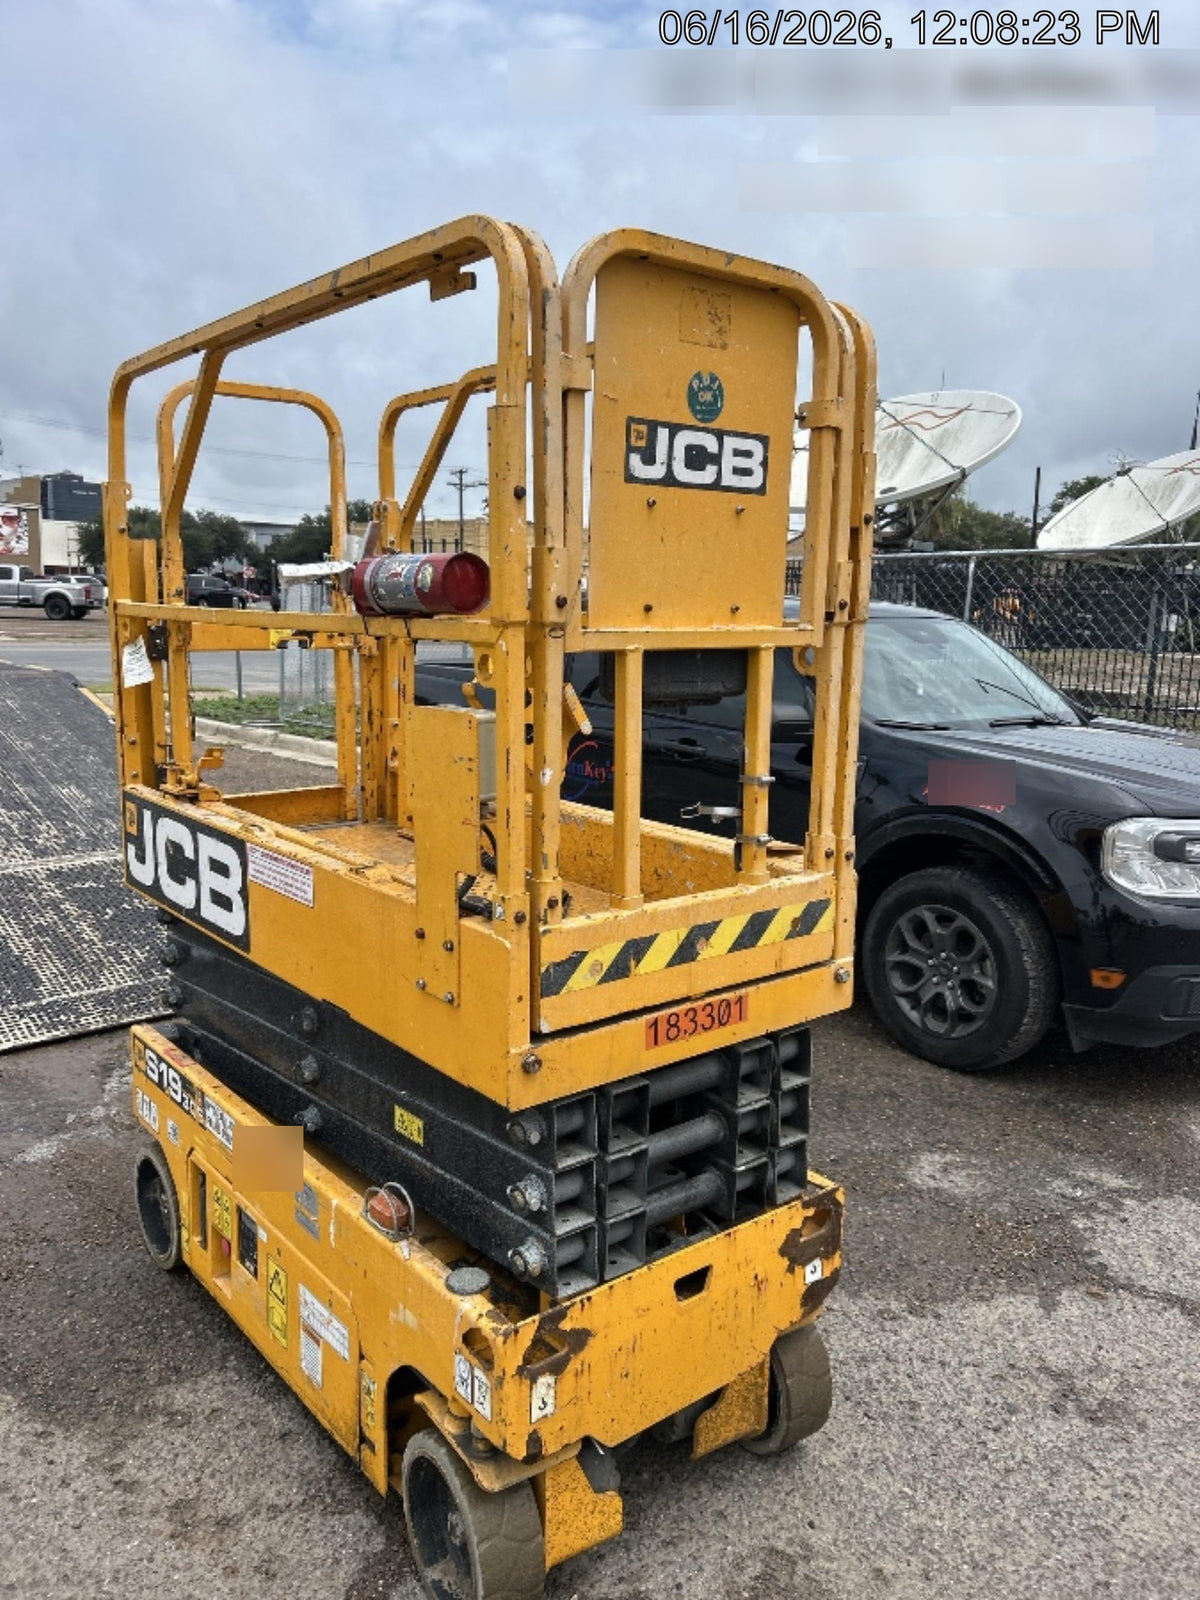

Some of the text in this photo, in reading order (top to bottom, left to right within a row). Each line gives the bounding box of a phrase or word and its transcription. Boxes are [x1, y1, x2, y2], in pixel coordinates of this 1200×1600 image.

[698, 391, 714, 403] OK
[629, 426, 764, 489] JCB
[127, 808, 246, 937] JCB
[648, 995, 745, 1046] 183301
